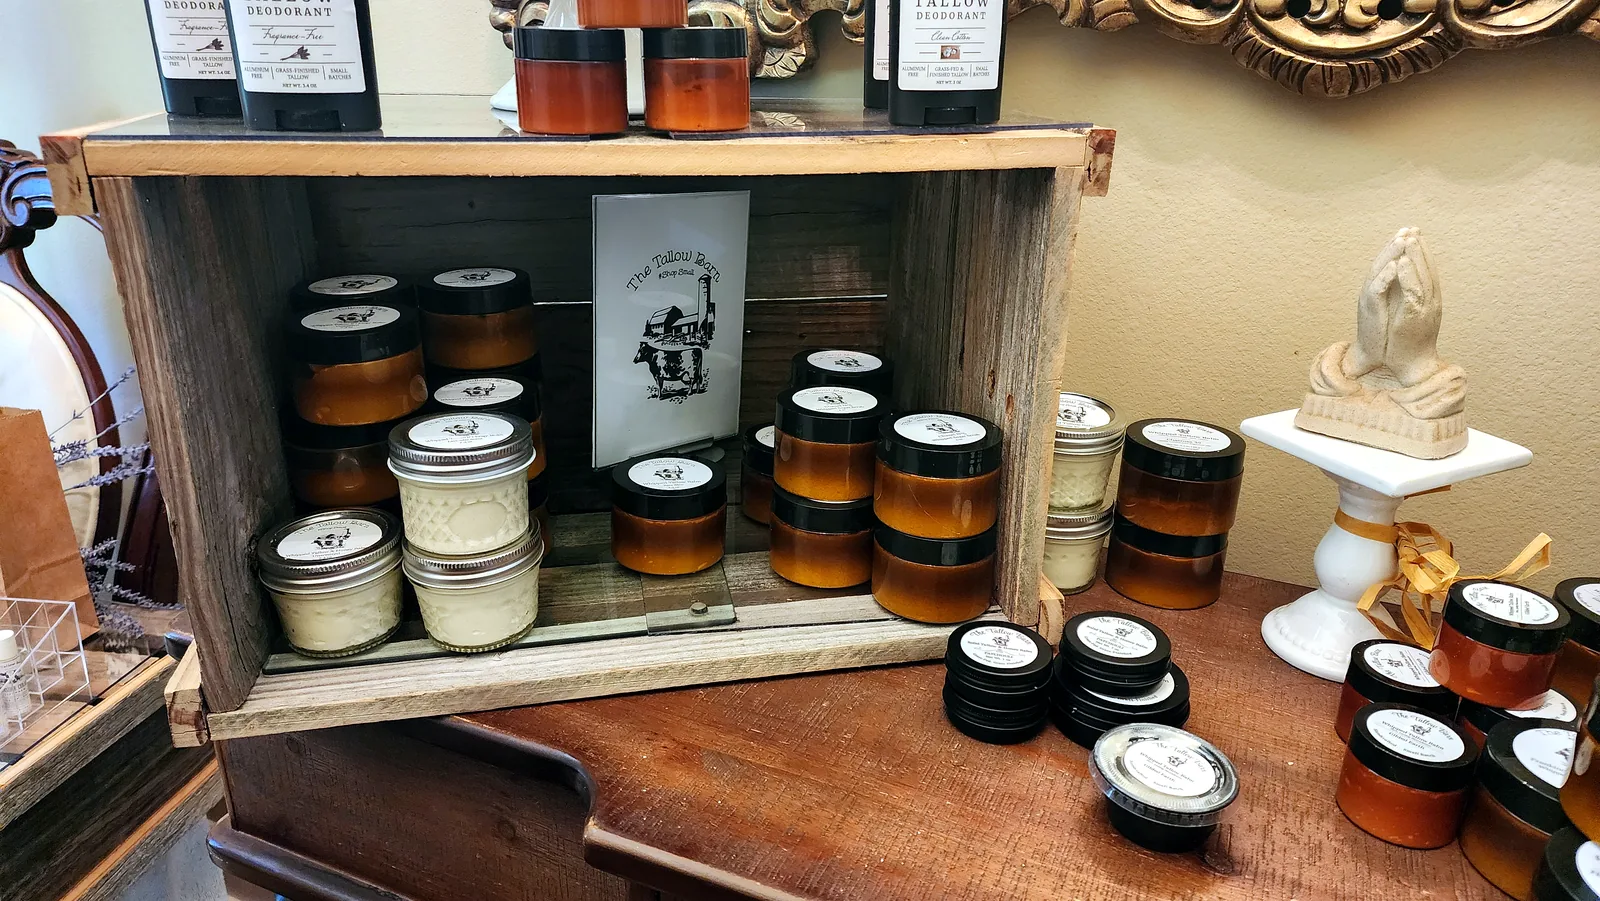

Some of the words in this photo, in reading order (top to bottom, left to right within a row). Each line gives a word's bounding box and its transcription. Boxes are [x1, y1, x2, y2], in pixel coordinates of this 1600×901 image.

[164, 1, 225, 10] DEODORA
[247, 6, 332, 17] DEODORANT
[916, 12, 987, 20] DEODORANT
[178, 19, 228, 35] Fragrance-F
[261, 27, 323, 44] Fragrance-Free
[930, 30, 950, 41] Clean
[626, 265, 652, 291] The
[652, 250, 693, 269] Tallow
[694, 252, 721, 283] Barn
[1112, 618, 1140, 630] Tallow
[986, 628, 1014, 636] Tallow
[1410, 715, 1438, 728] Tallow
[1382, 720, 1408, 734] Whipped
[1408, 731, 1428, 744] Tallow
[1170, 746, 1194, 760] Tallow
